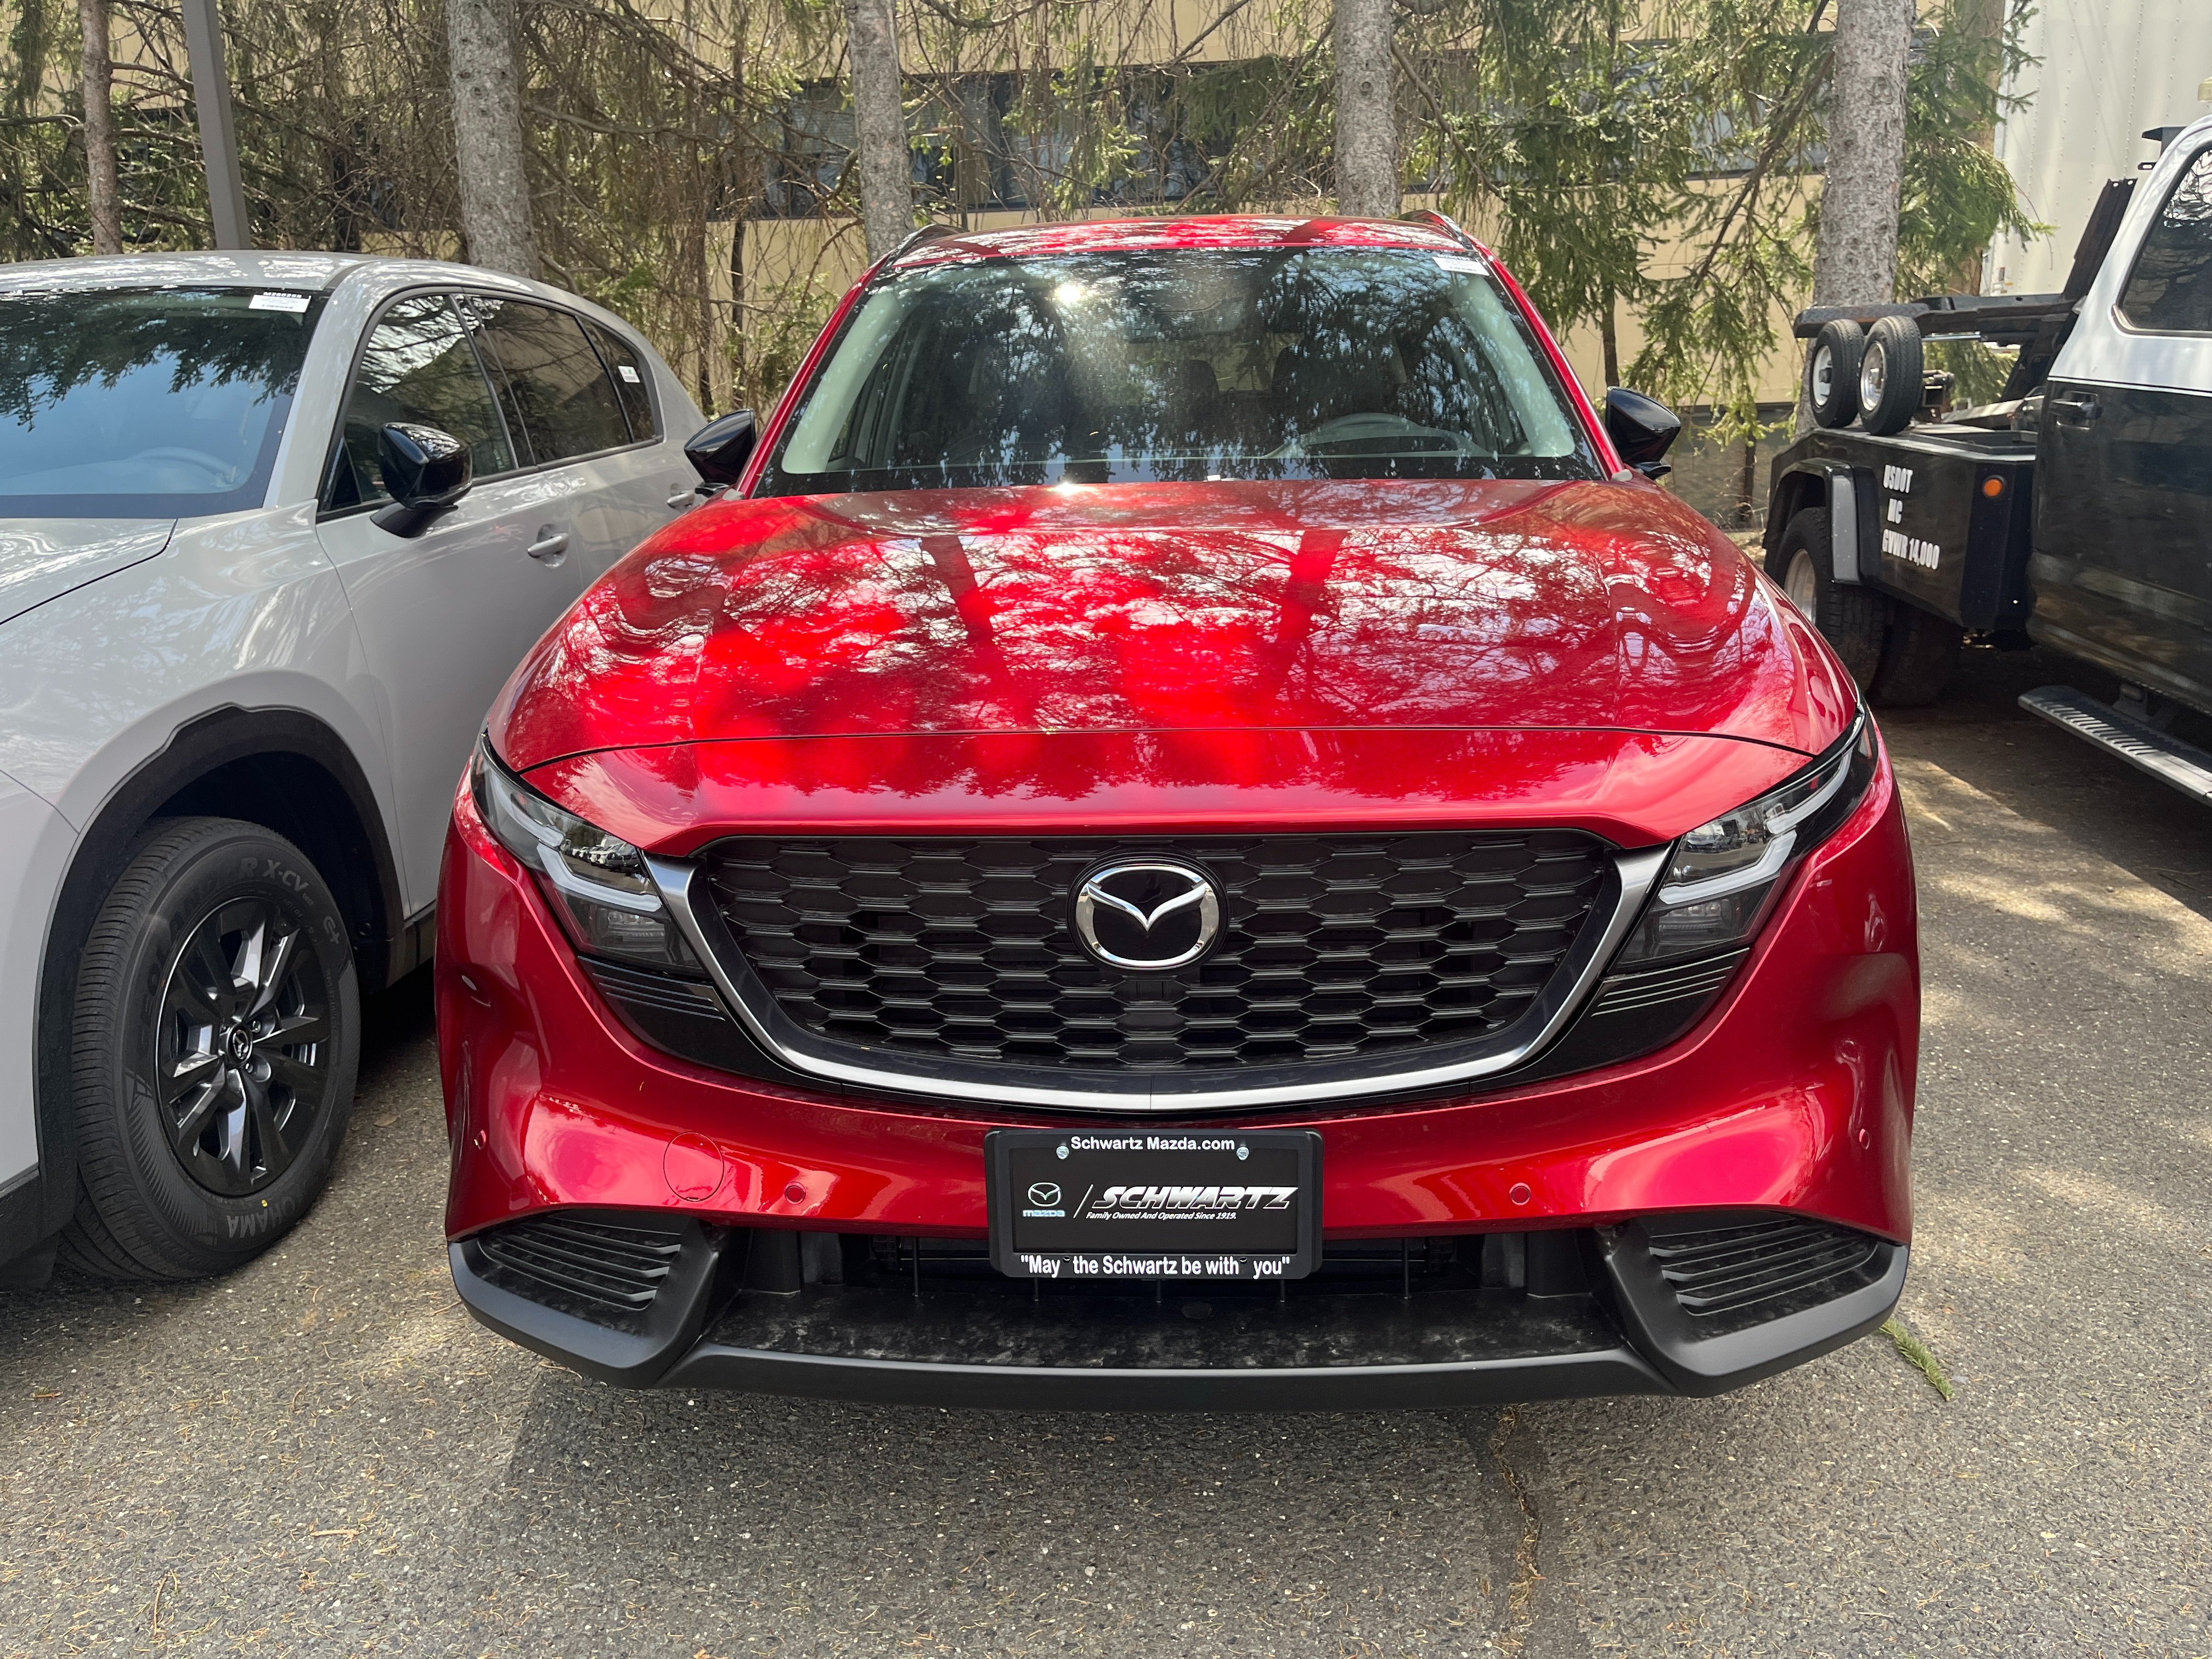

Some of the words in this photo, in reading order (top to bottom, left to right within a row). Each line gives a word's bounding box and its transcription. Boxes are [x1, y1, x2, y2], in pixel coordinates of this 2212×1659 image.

[1883, 465, 1913, 493] USDOT
[1887, 498, 1903, 524] MC
[1882, 529, 1908, 559] GVWR
[1909, 538, 1940, 570] 14,000
[1071, 1136, 1143, 1150] Schwartz
[1147, 1136, 1234, 1150] Mazda.com
[1091, 1186, 1298, 1209] SCHWARTZ
[1086, 1211, 1111, 1220] Family
[1158, 1212, 1194, 1220] Operated
[1020, 1255, 1060, 1278] "May
[1073, 1255, 1098, 1274] the
[1103, 1255, 1178, 1274] Schwartz
[1181, 1256, 1201, 1274] be
[1205, 1256, 1239, 1274] with
[1252, 1256, 1290, 1279] you"
